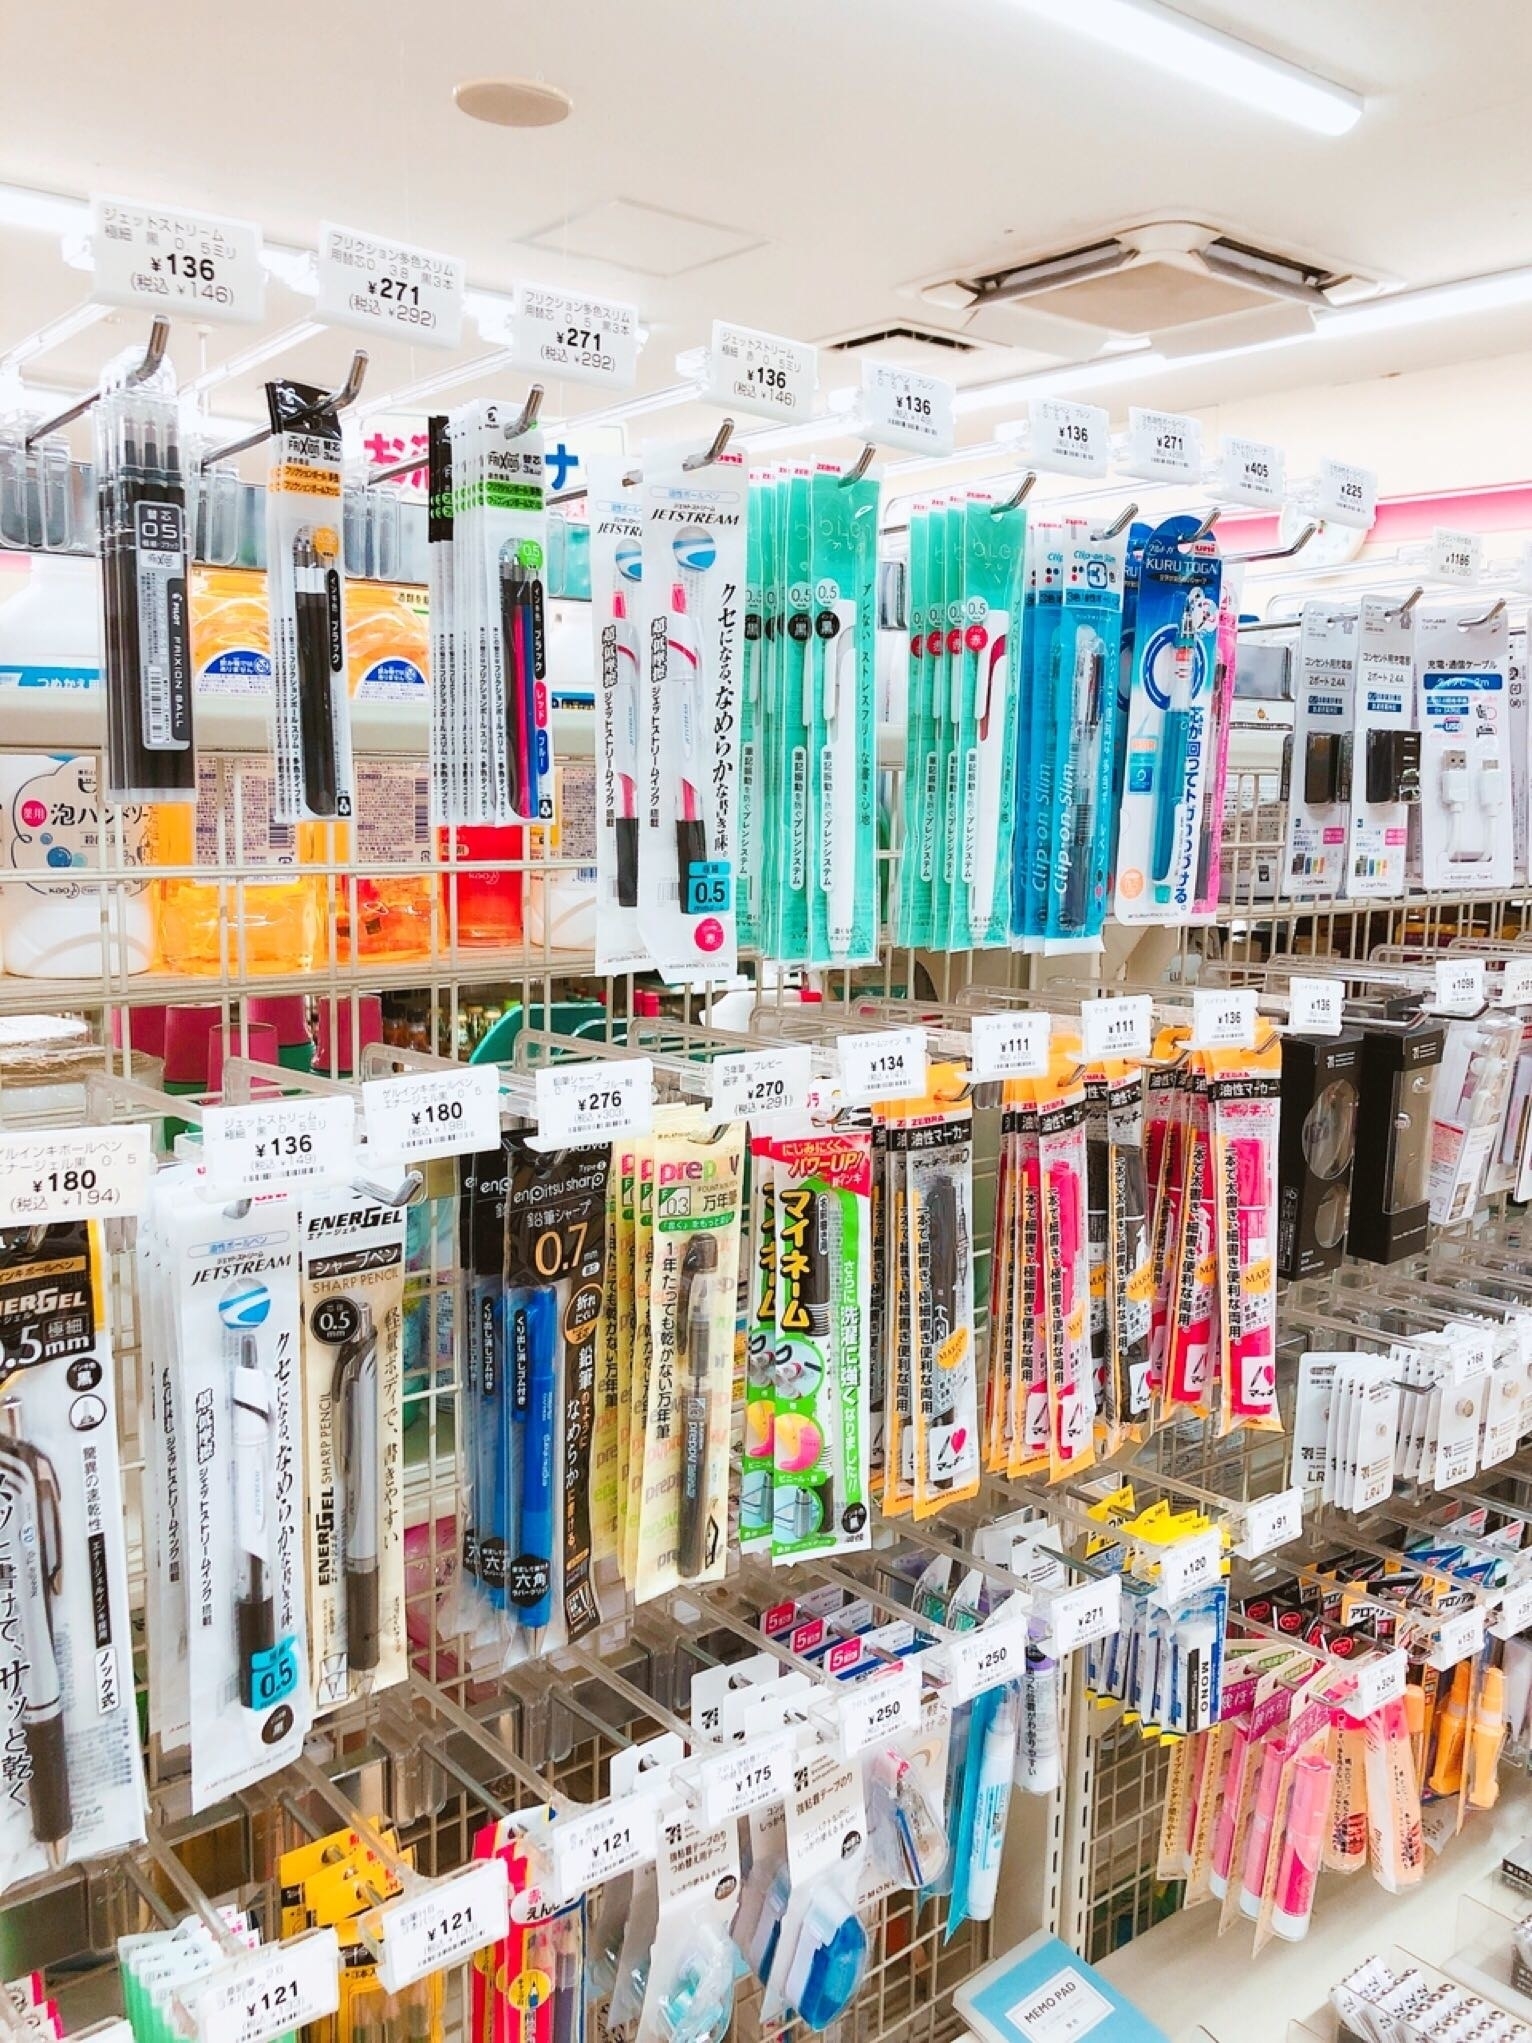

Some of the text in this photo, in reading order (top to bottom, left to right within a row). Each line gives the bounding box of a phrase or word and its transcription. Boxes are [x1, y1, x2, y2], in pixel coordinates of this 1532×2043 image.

[102, 207, 224, 243] ジェットストリーム
[331, 233, 454, 277] フリクション多色スリム
[150, 254, 215, 282] ¥136
[131, 273, 234, 306] (税込 ¥146)
[368, 277, 420, 306] ¥271
[349, 293, 437, 329] (税込 ¥292)
[525, 290, 631, 324] フリクション多色スリム
[556, 328, 602, 351] ¥271
[722, 332, 794, 360] ジェットストリーム
[540, 345, 617, 372] (税込 ¥292)
[747, 366, 787, 389] ¥136
[760, 384, 796, 407] ¥146)
[896, 396, 931, 416] ¥136
[1059, 425, 1088, 443] ¥136
[1157, 433, 1183, 451] ¥271
[816, 463, 842, 473] ZEBRA
[1244, 462, 1269, 477] ¥405
[1340, 484, 1362, 499] ¥225
[650, 509, 740, 526] JETSTREAM
[1194, 544, 1216, 553] uni
[818, 584, 838, 599] 0.5
[968, 602, 986, 615] 0.5
[173, 636, 183, 689] FRIXION
[174, 693, 184, 728] BALL
[603, 692, 615, 807] ジェットストリームインク
[649, 686, 662, 807] ジェットストリームインク
[1032, 763, 1051, 893] Clip-on Slim
[1054, 762, 1074, 895] Clip-on Slim
[695, 880, 726, 904] 0.5
[1310, 999, 1331, 1013] ¥136
[1108, 1020, 1135, 1035] ¥111
[1217, 1011, 1241, 1026] ¥136
[1000, 1037, 1030, 1053] ¥111
[870, 1055, 904, 1071] ¥134
[1219, 1072, 1250, 1080] ZEBRA
[382, 1078, 475, 1098] ゲルインキボールペン
[747, 1080, 785, 1100] ¥270
[1220, 1082, 1278, 1097] 油性マーカー
[577, 1091, 622, 1111] ¥276
[760, 1095, 794, 1111] ¥291)
[1041, 1099, 1066, 1112] ZEBRA
[224, 1111, 317, 1129] ジェットストリーム
[411, 1101, 463, 1125] ¥180
[911, 1115, 945, 1127] ZEBRA
[255, 1134, 313, 1158] ¥136
[911, 1126, 970, 1147] 油性マーカー
[0, 1142, 122, 1160] ルインキボールペン
[33, 1169, 97, 1193] ¥180
[513, 1172, 605, 1204] enpitsu sharp
[11, 1188, 120, 1214] (税込 ¥194)
[703, 1190, 737, 1212] 万年筆
[307, 1206, 403, 1233] ENERGEL
[526, 1200, 593, 1228] 鉛筆シャープ
[307, 1227, 357, 1241] エナージェル
[534, 1222, 589, 1277] 0.7
[780, 1190, 812, 1331] マイネーム
[191, 1254, 292, 1287] JETSTREAM
[314, 1247, 399, 1277] シャープペン
[312, 1270, 399, 1294] SHARP PENCIL
[319, 1312, 350, 1332] 0.5
[45, 1335, 90, 1358] mm
[317, 1392, 334, 1586] ENERGEL SHARP PENCIL
[1271, 1516, 1288, 1530] ¥91
[1182, 1557, 1207, 1575] ¥120
[516, 1572, 547, 1587] 六角
[1078, 1606, 1104, 1626] ¥271
[977, 1648, 1007, 1671] ¥250
[100, 1651, 117, 1708] ノック式
[260, 1664, 293, 1698] 0.5
[1200, 1660, 1210, 1713] MONO
[868, 1701, 901, 1726] ¥250
[735, 1764, 772, 1793] ¥175
[592, 1827, 632, 1858] ¥121
[427, 1906, 474, 1943] ¥121
[247, 1980, 299, 2017] ¥121
[1024, 1980, 1078, 2024] MEMO PAD
